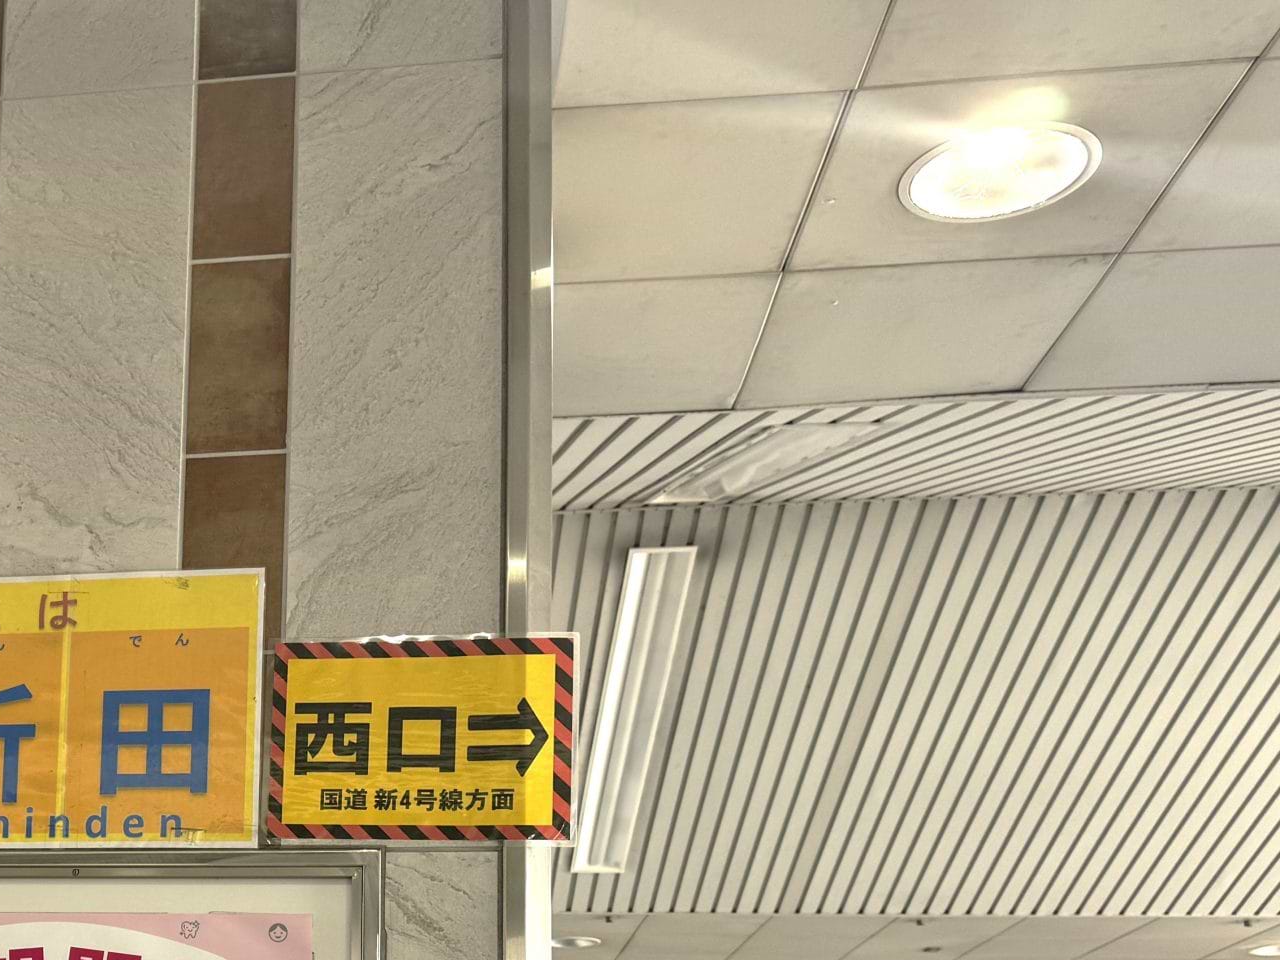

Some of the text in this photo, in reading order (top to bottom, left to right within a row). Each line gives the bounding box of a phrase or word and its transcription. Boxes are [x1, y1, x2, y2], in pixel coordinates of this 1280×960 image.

[129, 632, 191, 648] でん
[293, 700, 459, 779] 西口
[319, 788, 515, 813] 国道 新4号線方面
